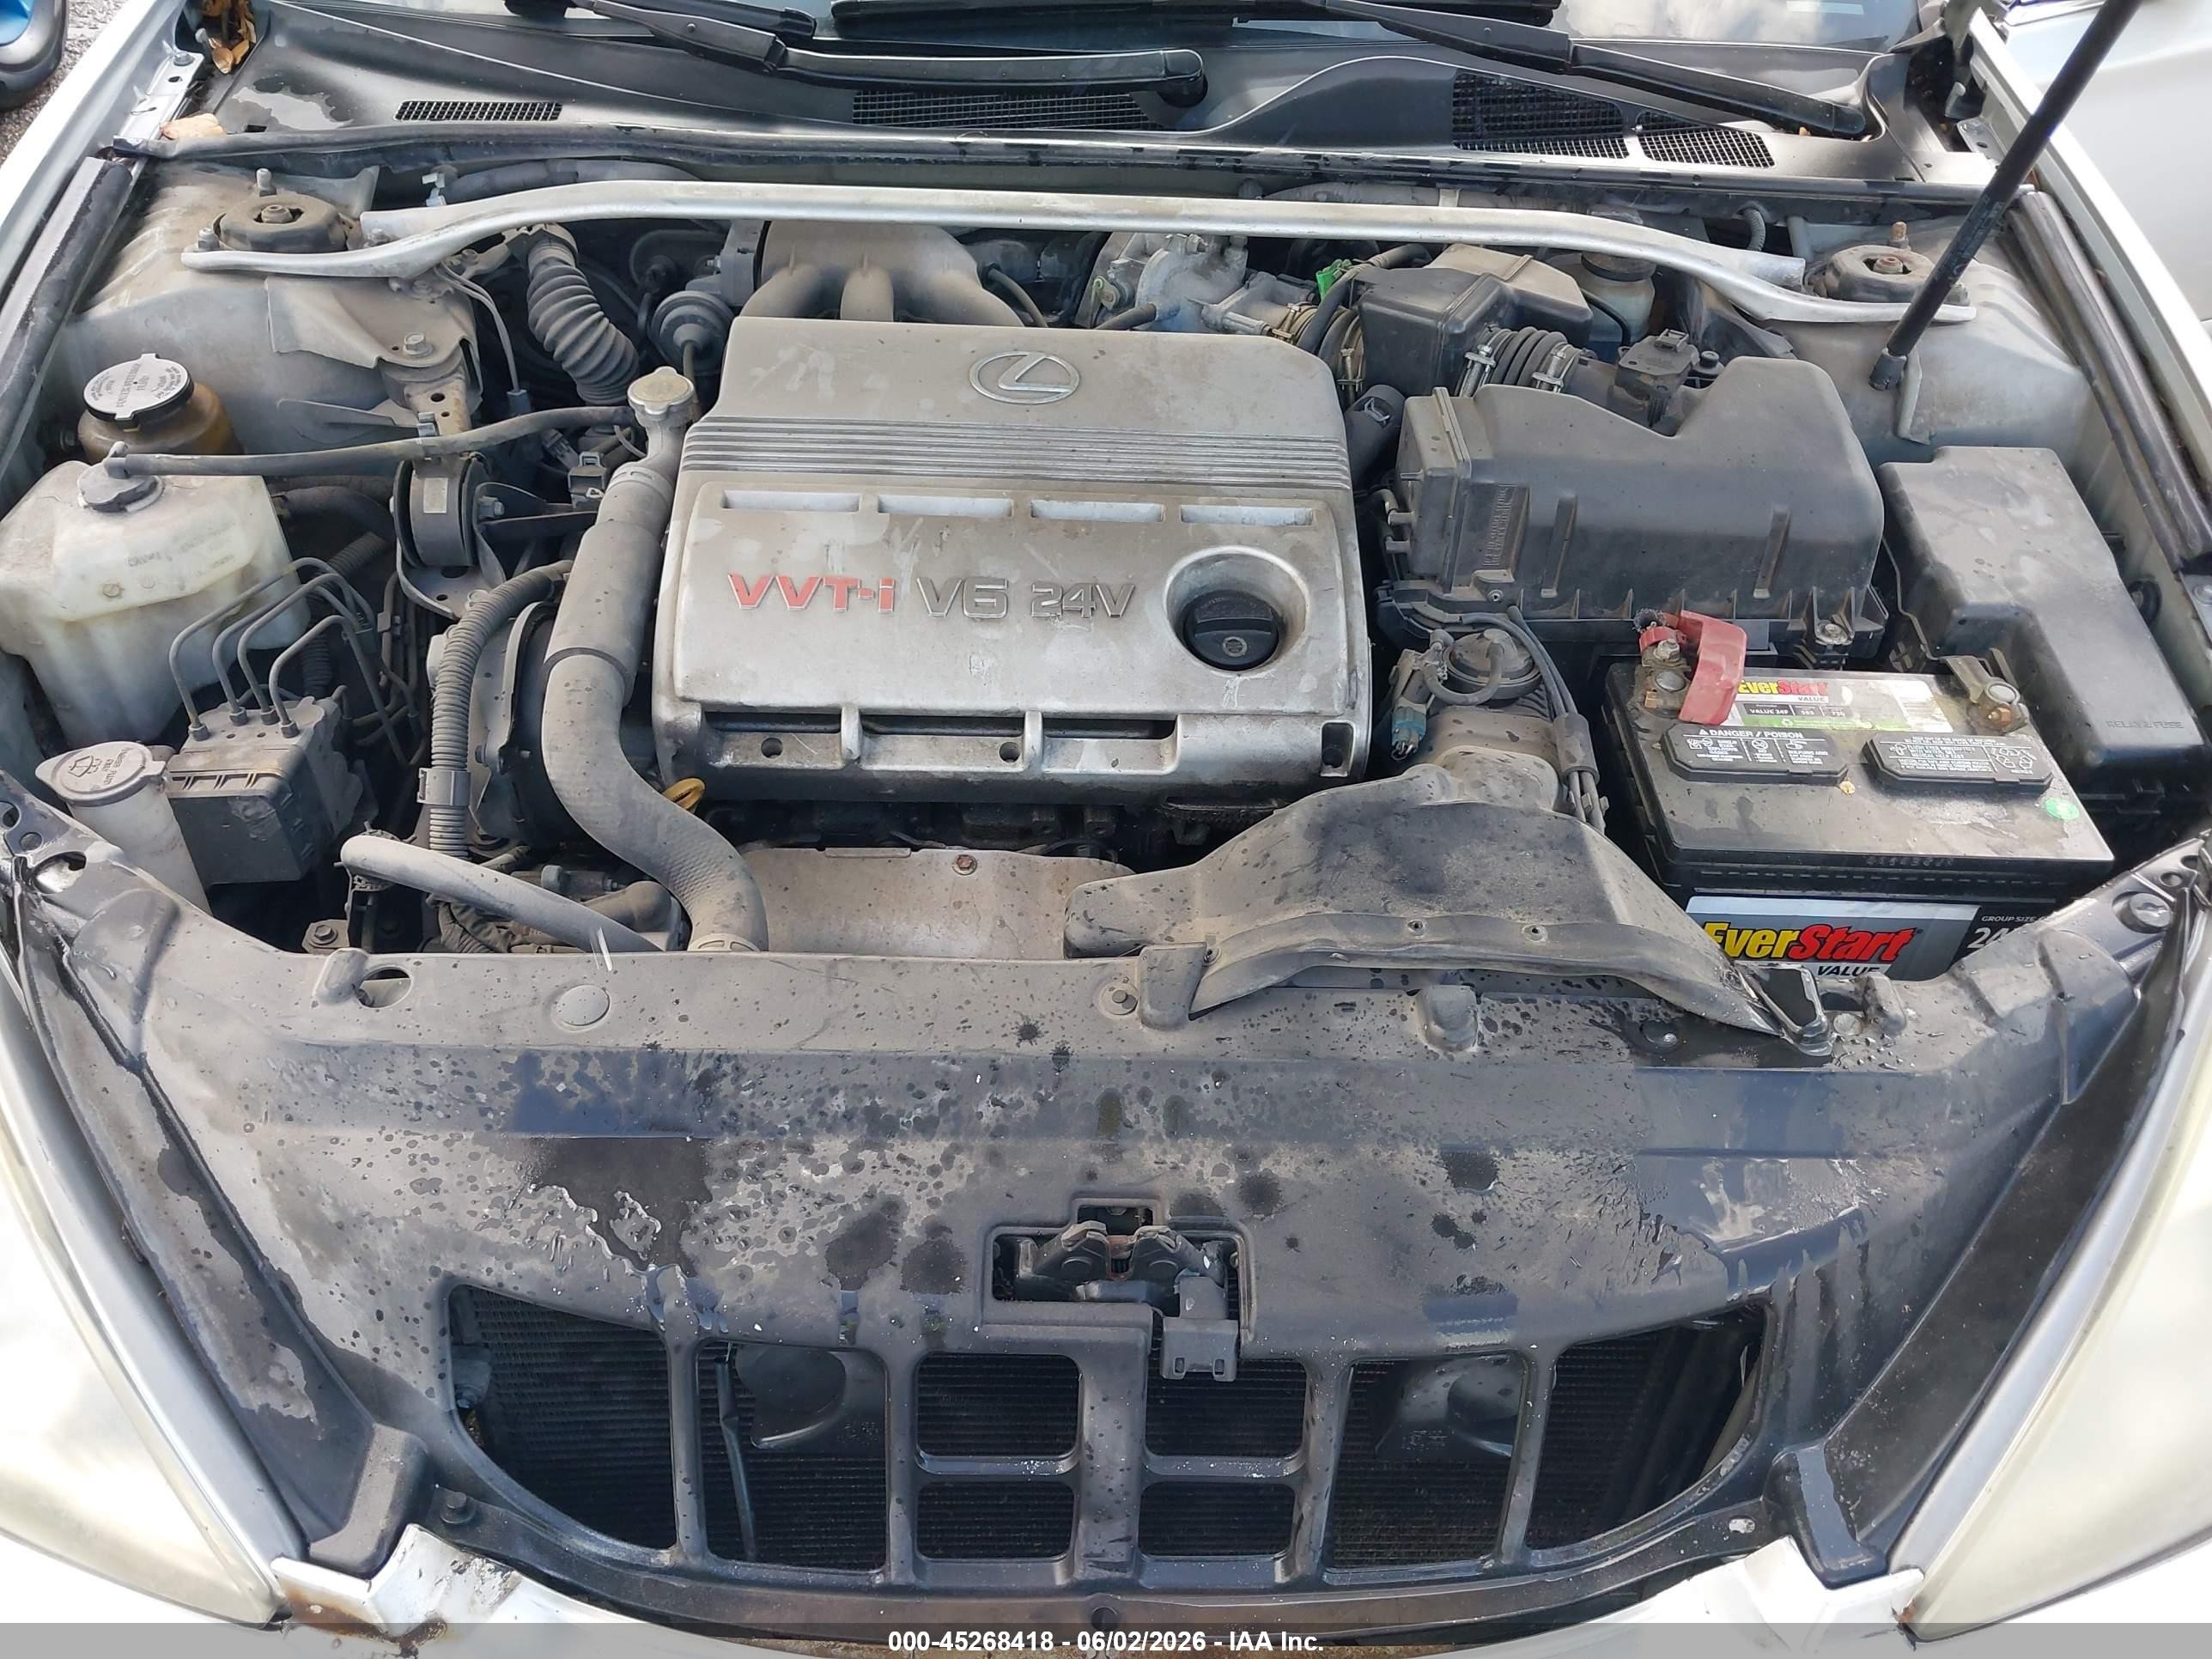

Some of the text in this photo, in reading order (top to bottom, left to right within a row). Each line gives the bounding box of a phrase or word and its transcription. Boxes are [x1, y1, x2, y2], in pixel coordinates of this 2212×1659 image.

[728, 573, 1135, 619] VVT-i V6 24V
[1738, 679, 1828, 696] EverStart
[1710, 729, 1753, 738] DANGER
